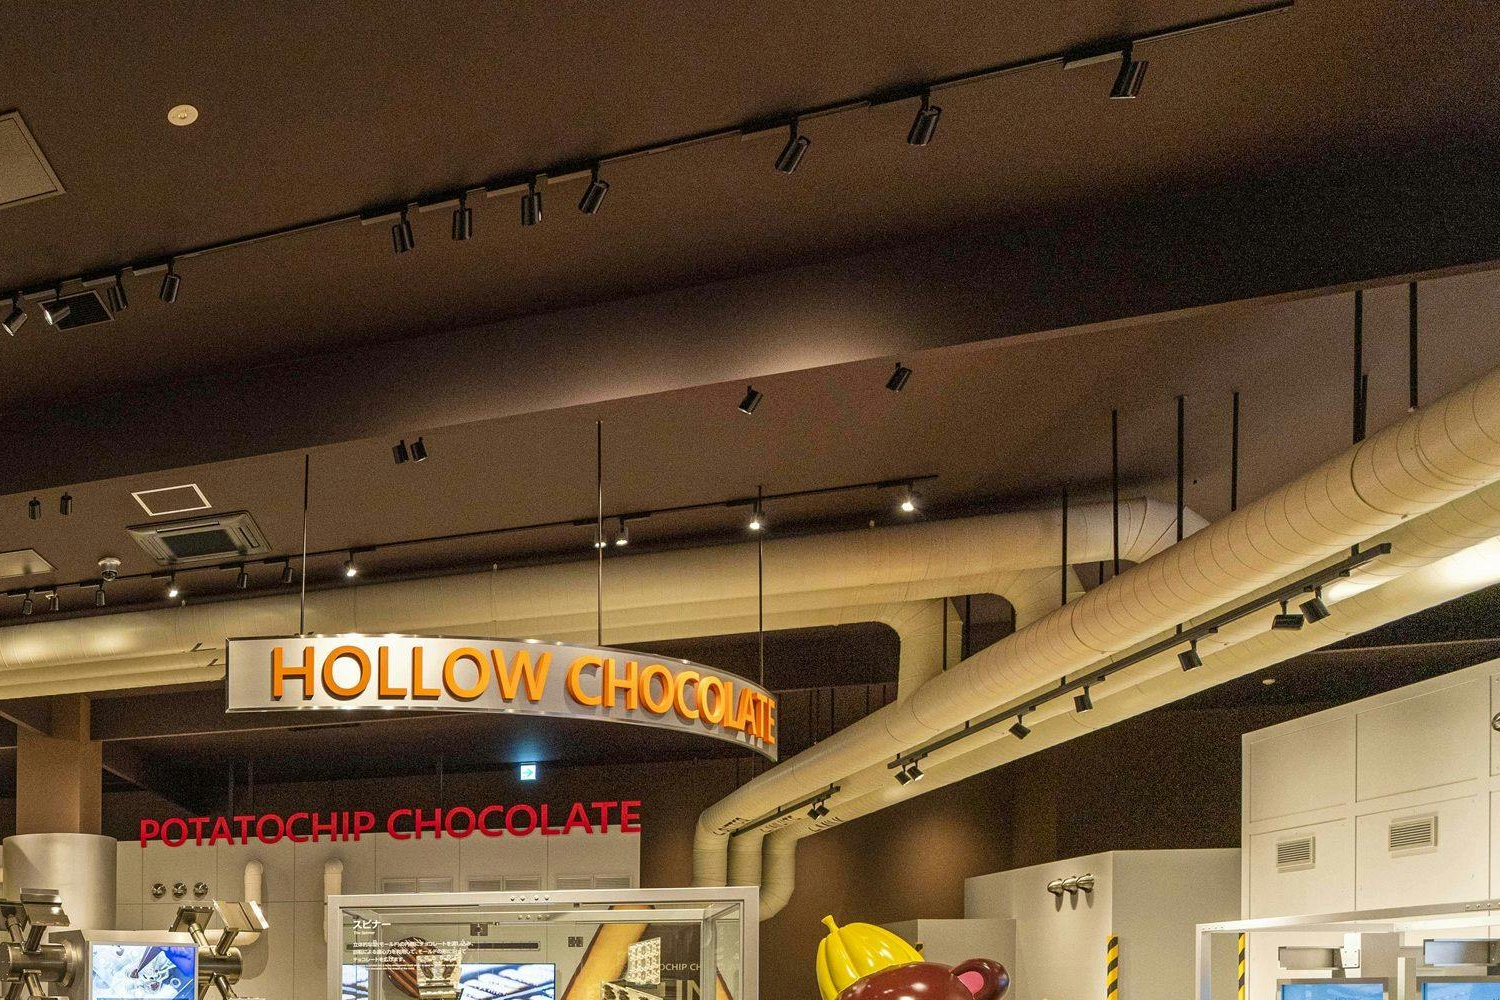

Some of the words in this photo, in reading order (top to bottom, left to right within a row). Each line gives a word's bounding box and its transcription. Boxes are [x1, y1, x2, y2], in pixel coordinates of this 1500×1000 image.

[271, 645, 553, 702] HOLLOW
[566, 654, 778, 746] CHOCOLATE
[139, 811, 375, 848] POTATOCHIP
[386, 800, 642, 840] CHOCOLATE
[353, 919, 392, 929] スピナー
